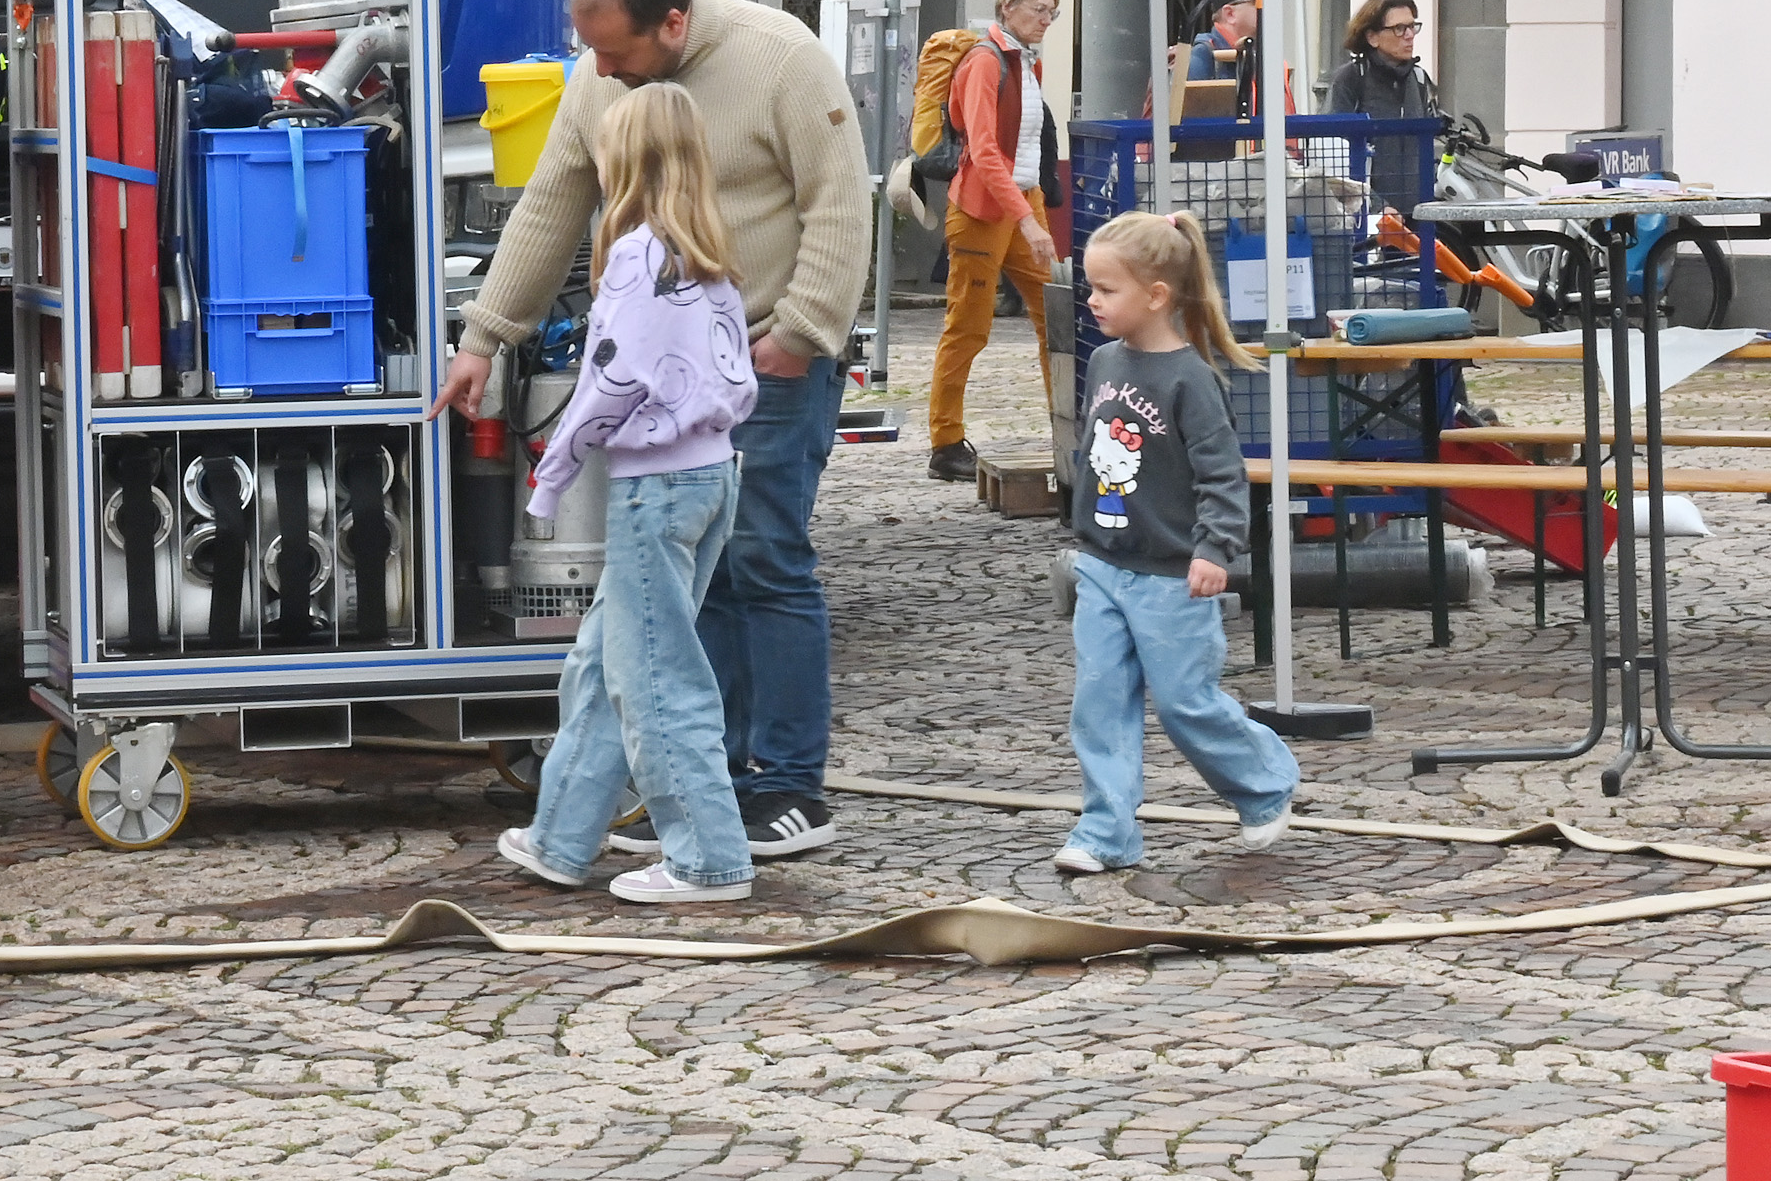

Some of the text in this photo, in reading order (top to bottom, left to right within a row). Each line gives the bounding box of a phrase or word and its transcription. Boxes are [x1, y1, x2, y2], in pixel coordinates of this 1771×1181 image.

[1603, 148, 1650, 175] VR Bank
[1117, 382, 1167, 436] Kitty
